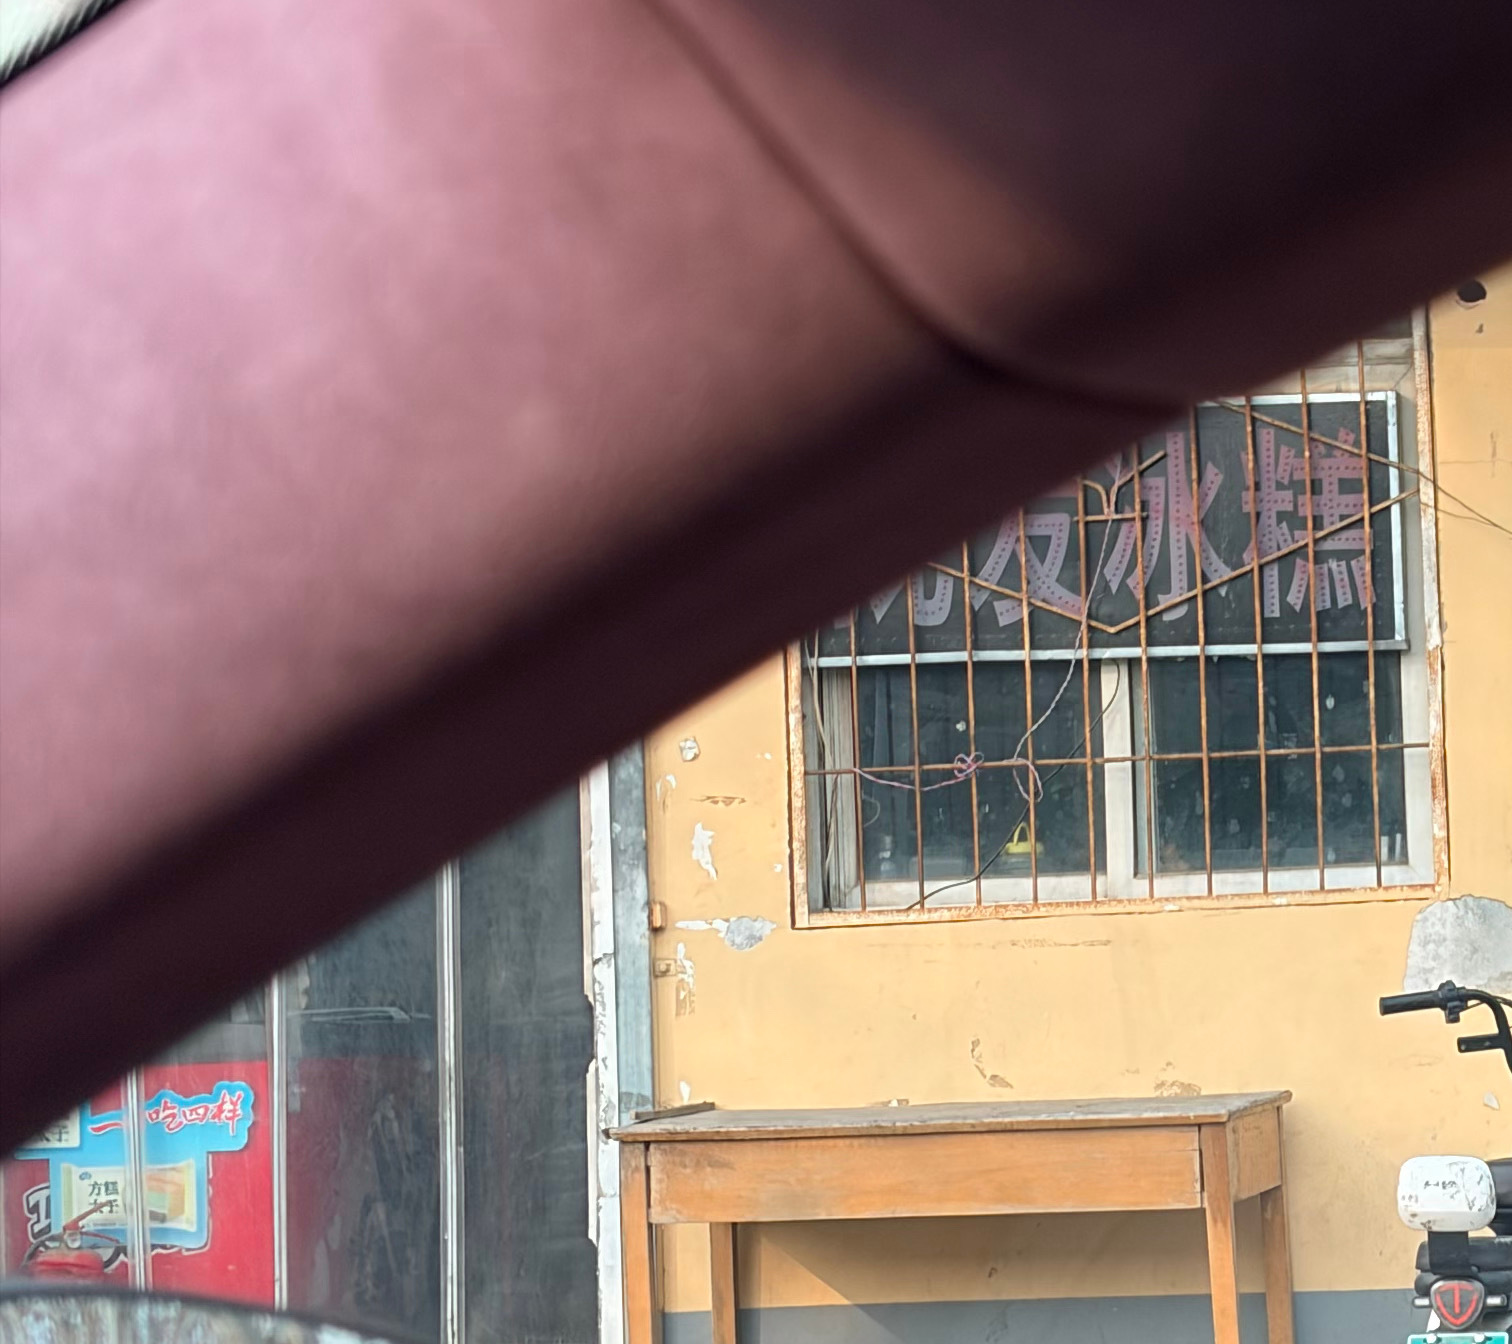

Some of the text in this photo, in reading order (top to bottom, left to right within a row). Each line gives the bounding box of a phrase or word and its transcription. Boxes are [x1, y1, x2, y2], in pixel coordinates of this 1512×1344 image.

[834, 428, 1376, 627] 发冰糕
[88, 1180, 119, 1197] 方糕
